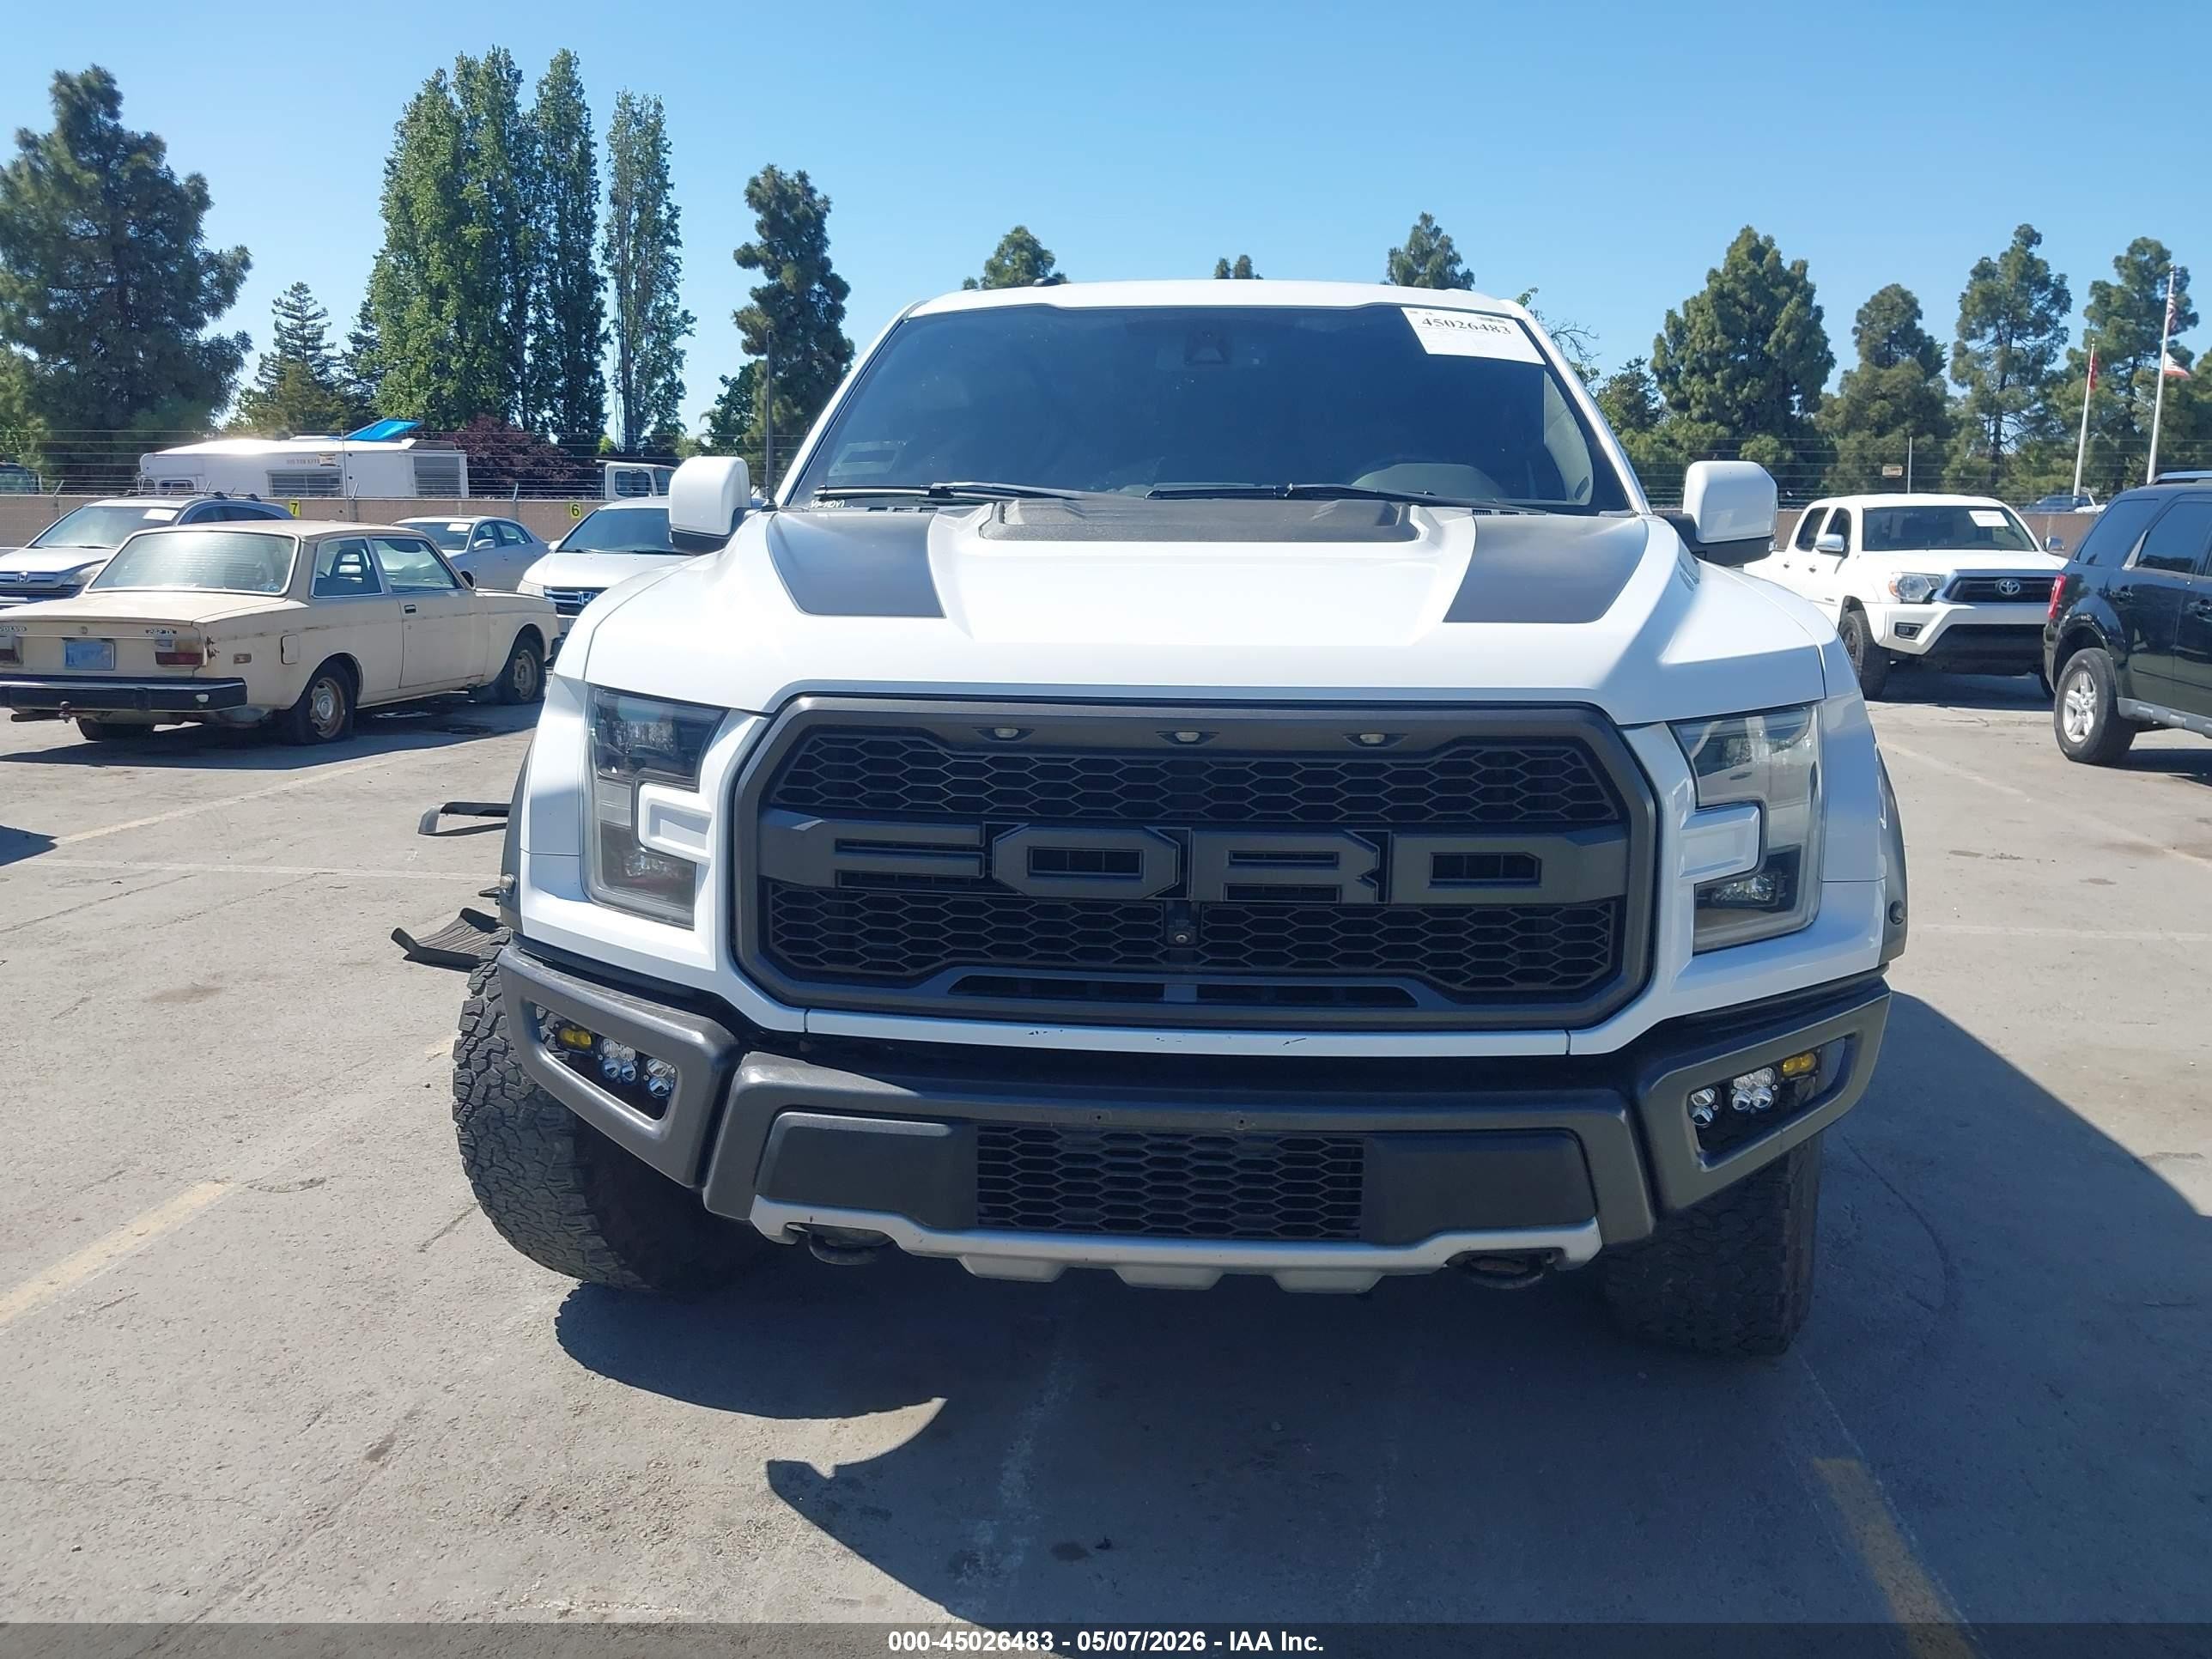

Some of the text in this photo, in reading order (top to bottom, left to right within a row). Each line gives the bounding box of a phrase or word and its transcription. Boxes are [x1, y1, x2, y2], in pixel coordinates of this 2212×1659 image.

[1422, 317, 1511, 335] 45026483
[290, 502, 298, 515] 7
[571, 504, 580, 517] 6
[759, 816, 1630, 904] FORD
